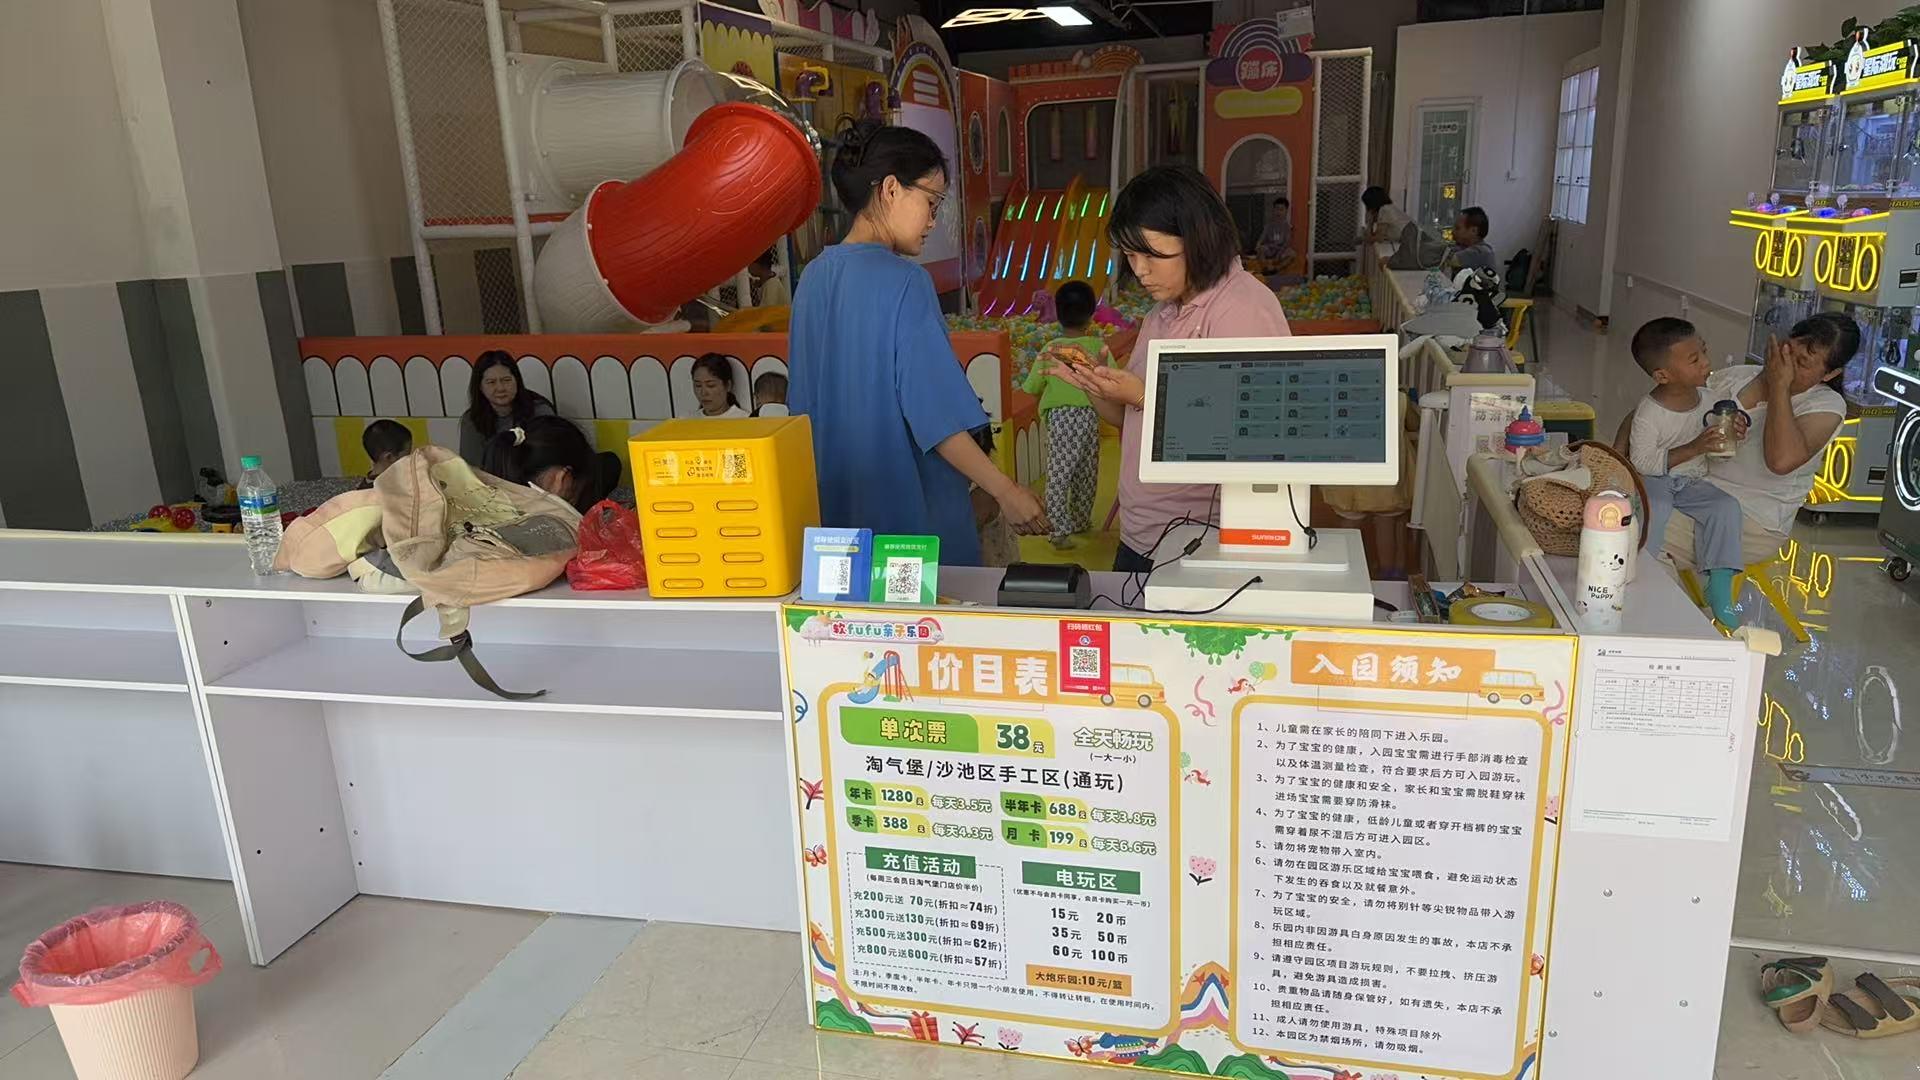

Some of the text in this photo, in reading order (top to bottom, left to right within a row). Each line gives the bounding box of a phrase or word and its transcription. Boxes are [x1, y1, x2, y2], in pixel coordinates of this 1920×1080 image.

[1588, 584, 1609, 593] NICE
[832, 623, 930, 638] 软fufu亲子乐园
[927, 651, 1051, 698] 价目表
[1309, 652, 1463, 684] 入园须知
[880, 716, 1155, 754] 单次票 38元 全天畅玩
[1256, 722, 1449, 744] 1、儿童需在家长的陪同下进入乐园。
[1256, 739, 1529, 766] 2、为了宝宝的健康，入园宝宝需进行手部消毒检查
[865, 755, 1125, 793] 淘气堡/沙池区手工区(通玩)
[1276, 757, 1521, 783] 以及体温测量检查，符合要求后方可入园游玩。
[849, 786, 873, 800] 年卡
[931, 795, 993, 813] 每天3.5元
[1275, 791, 1397, 810] 进场宝宝需要穿防滑袜。
[1005, 798, 1042, 813] 半年卡
[1091, 807, 1157, 827] 每天3.8元
[851, 814, 875, 828] 季卡
[932, 822, 994, 841] 每天4.3元
[1274, 825, 1431, 847] 需穿着尿不湿后方可进入园区。
[1091, 835, 1157, 855] 每天6.6元
[1255, 840, 1382, 860] 5、请勿将宠物带入室内。
[881, 853, 961, 876] 充值活动
[1056, 869, 1118, 891] 电玩区
[1051, 907, 1127, 927] 15元 20币
[1273, 906, 1311, 919] 玩区域。
[1052, 926, 1128, 946] 35元 50币
[1052, 945, 1129, 965] 60元 100币
